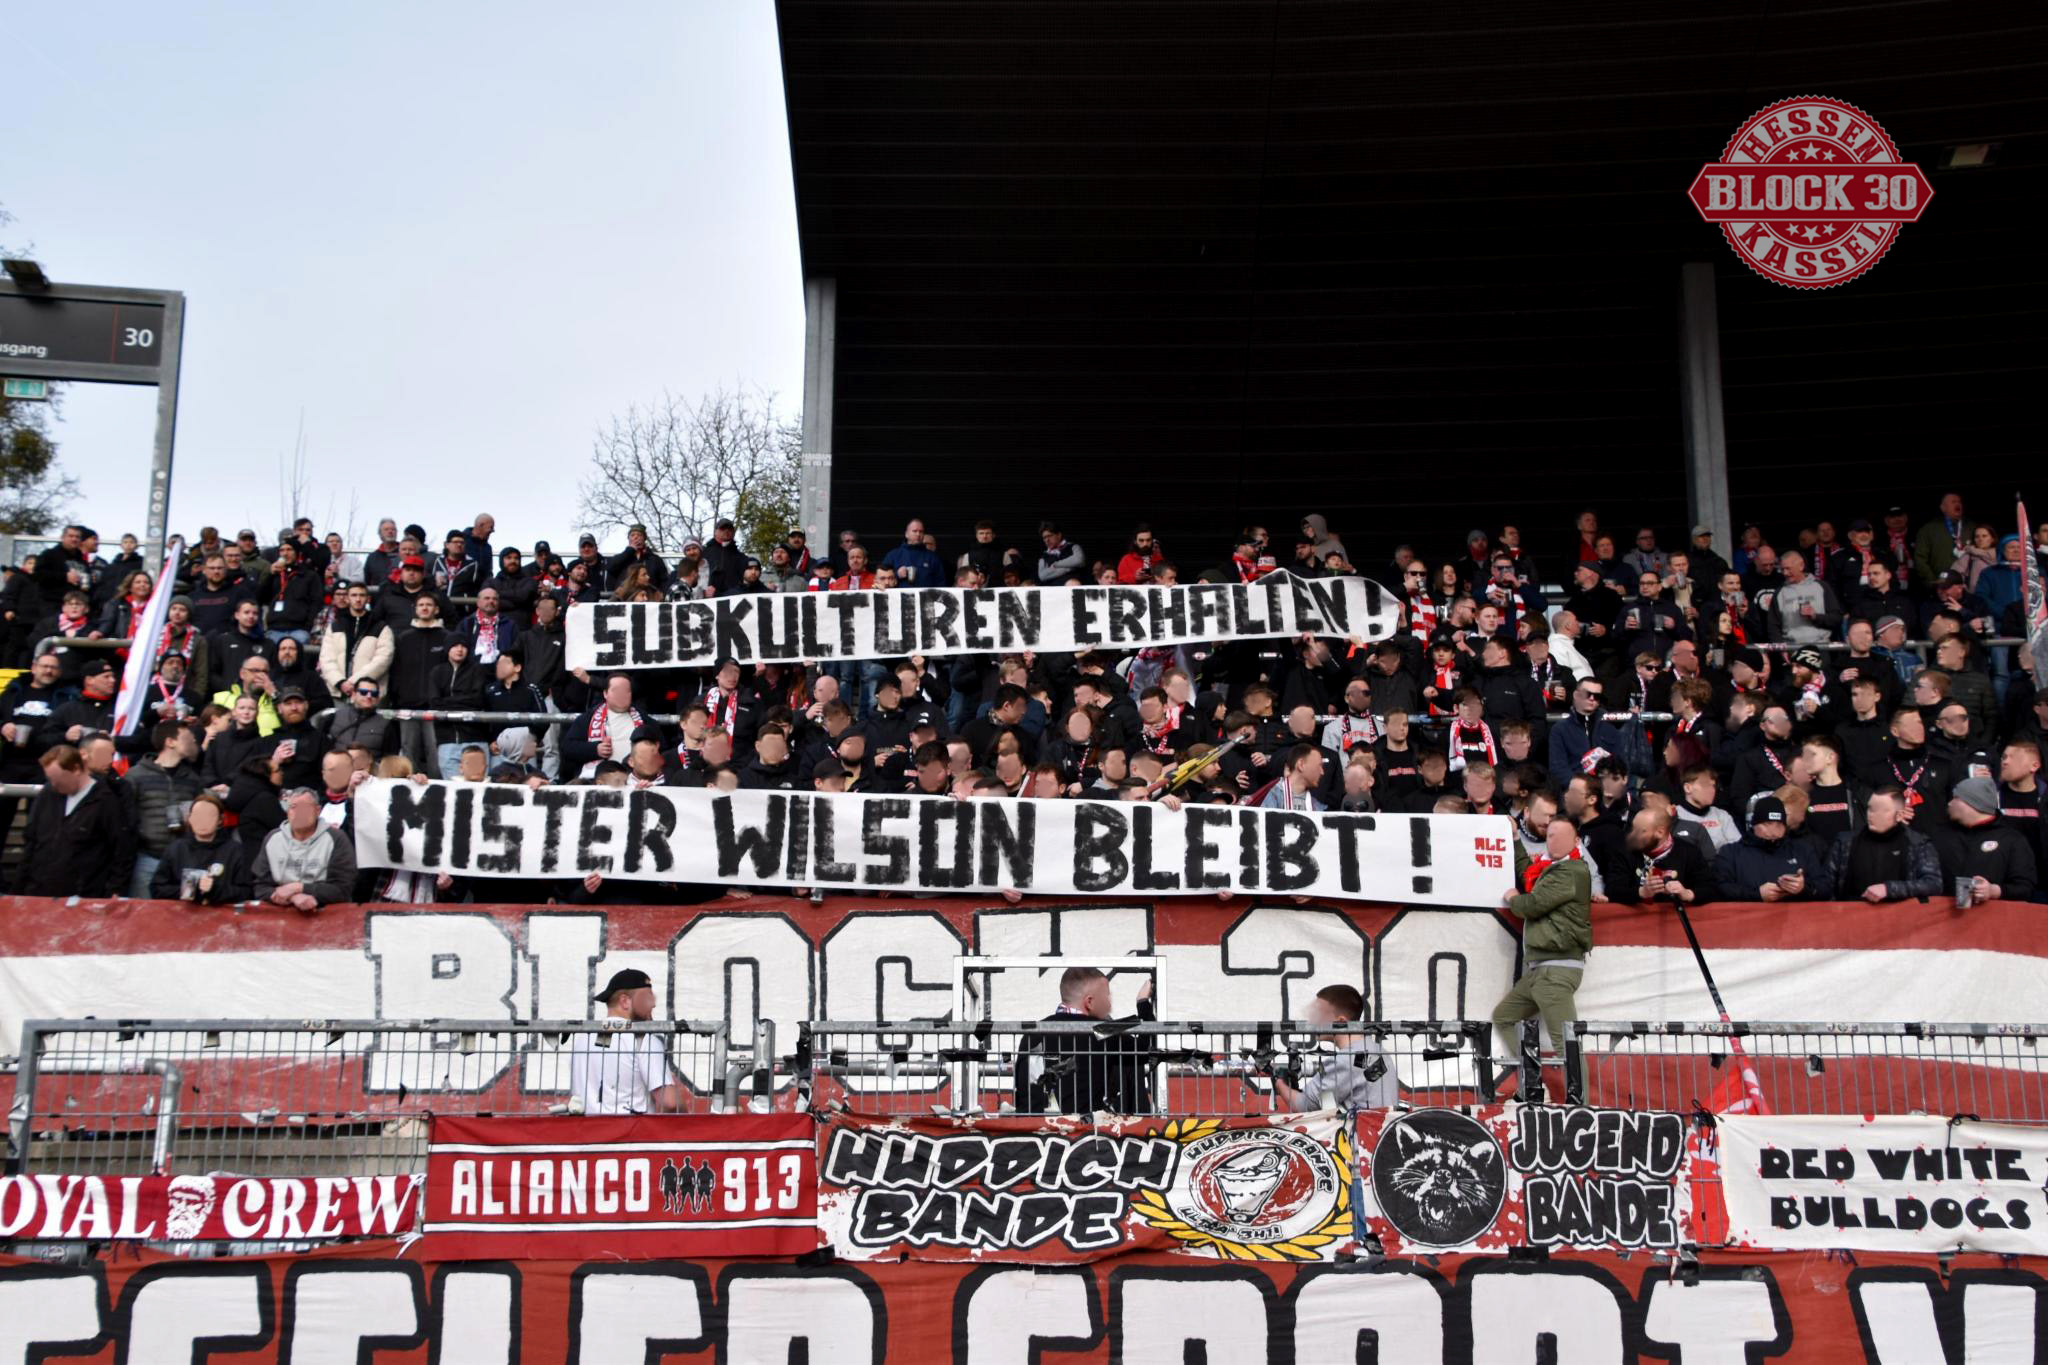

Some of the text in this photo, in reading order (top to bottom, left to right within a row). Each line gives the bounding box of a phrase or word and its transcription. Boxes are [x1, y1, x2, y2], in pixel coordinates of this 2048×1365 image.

[123, 328, 153, 347] 30
[593, 569, 1383, 666] SUBKULTUREN ERHALTEN!
[387, 784, 677, 873] MISTER
[712, 793, 1036, 889] WILSON
[1072, 803, 1376, 893] BLEIBT
[1475, 853, 1503, 869] 913
[1511, 1106, 1686, 1178] JUGEND
[1759, 1147, 2032, 1182] RED WHITE
[0, 1174, 422, 1239] OYAL CREW
[450, 1155, 801, 1216] ALIANCO 913
[1523, 1173, 1679, 1248] BANDE
[1770, 1195, 2032, 1231] BULLDOGS
[853, 1190, 1125, 1249] BANDE
